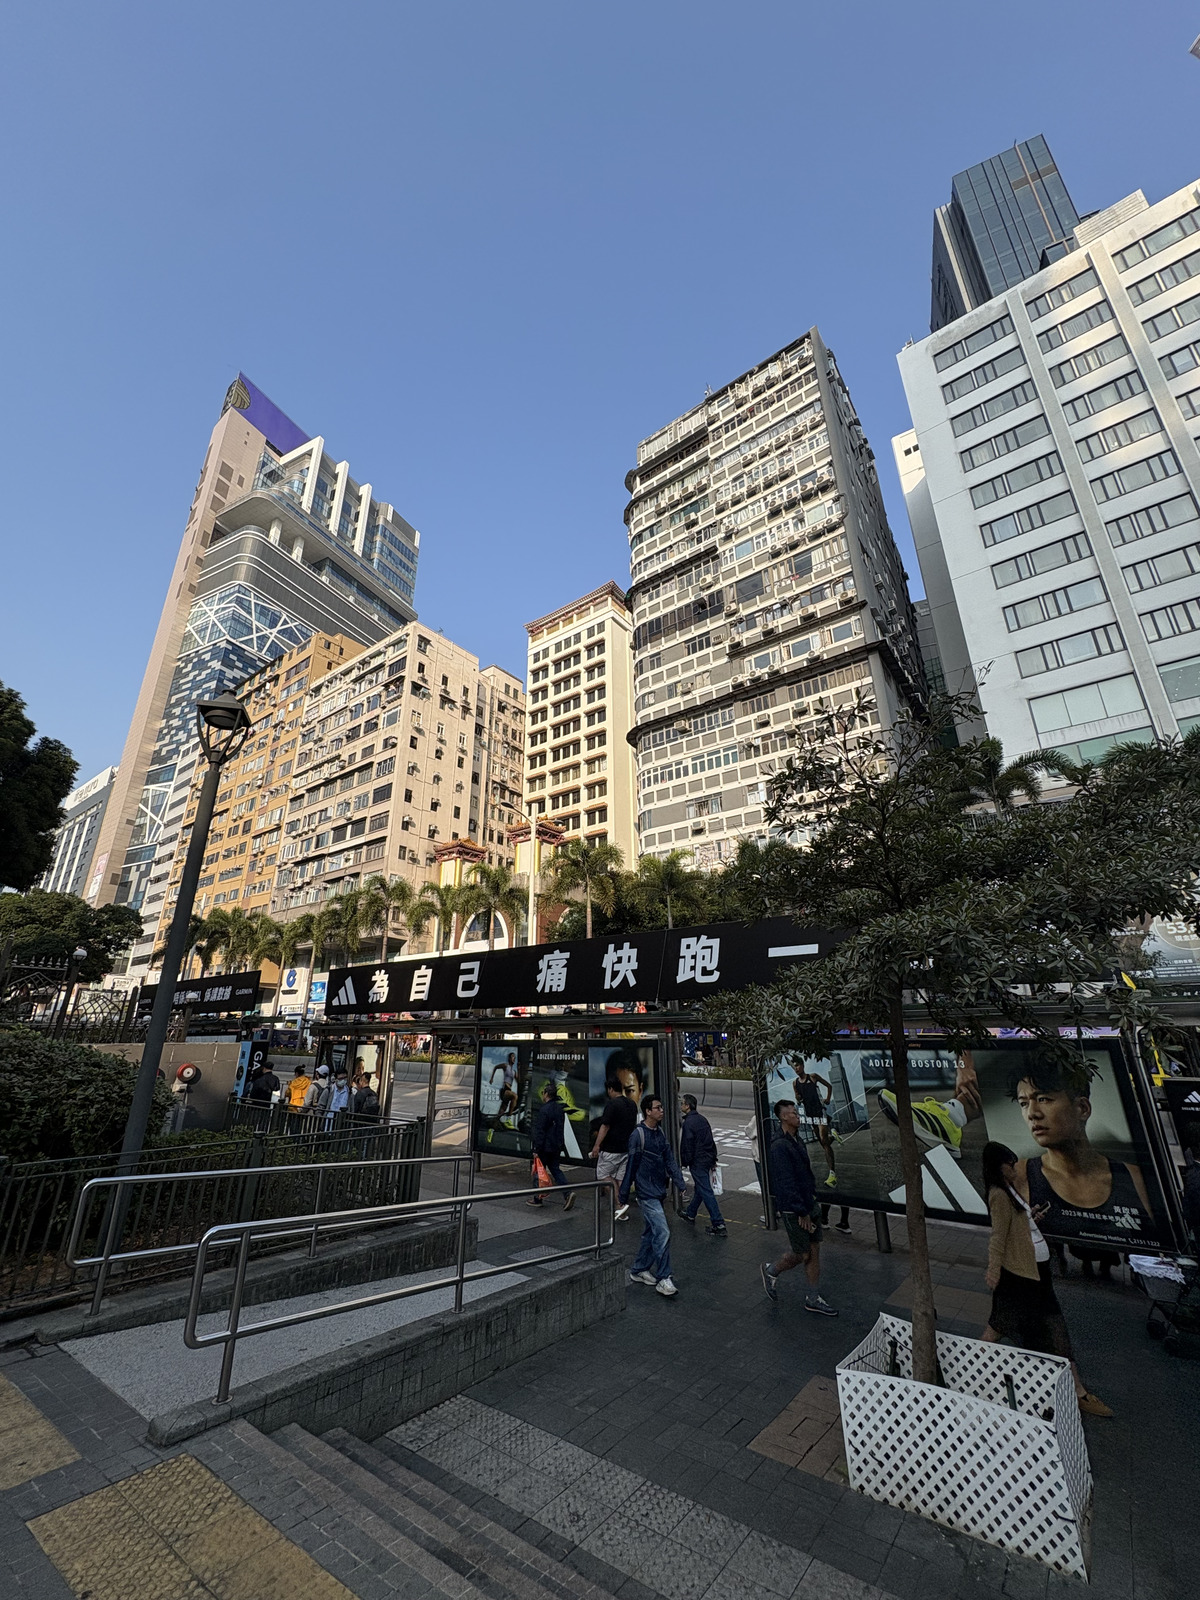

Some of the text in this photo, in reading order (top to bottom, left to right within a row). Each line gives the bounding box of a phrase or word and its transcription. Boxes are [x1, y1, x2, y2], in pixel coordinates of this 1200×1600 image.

[368, 961, 481, 1004] 為自己
[236, 988, 253, 996] GARMIN
[911, 1059, 949, 1068] BOSTON
[953, 1060, 965, 1069] 13
